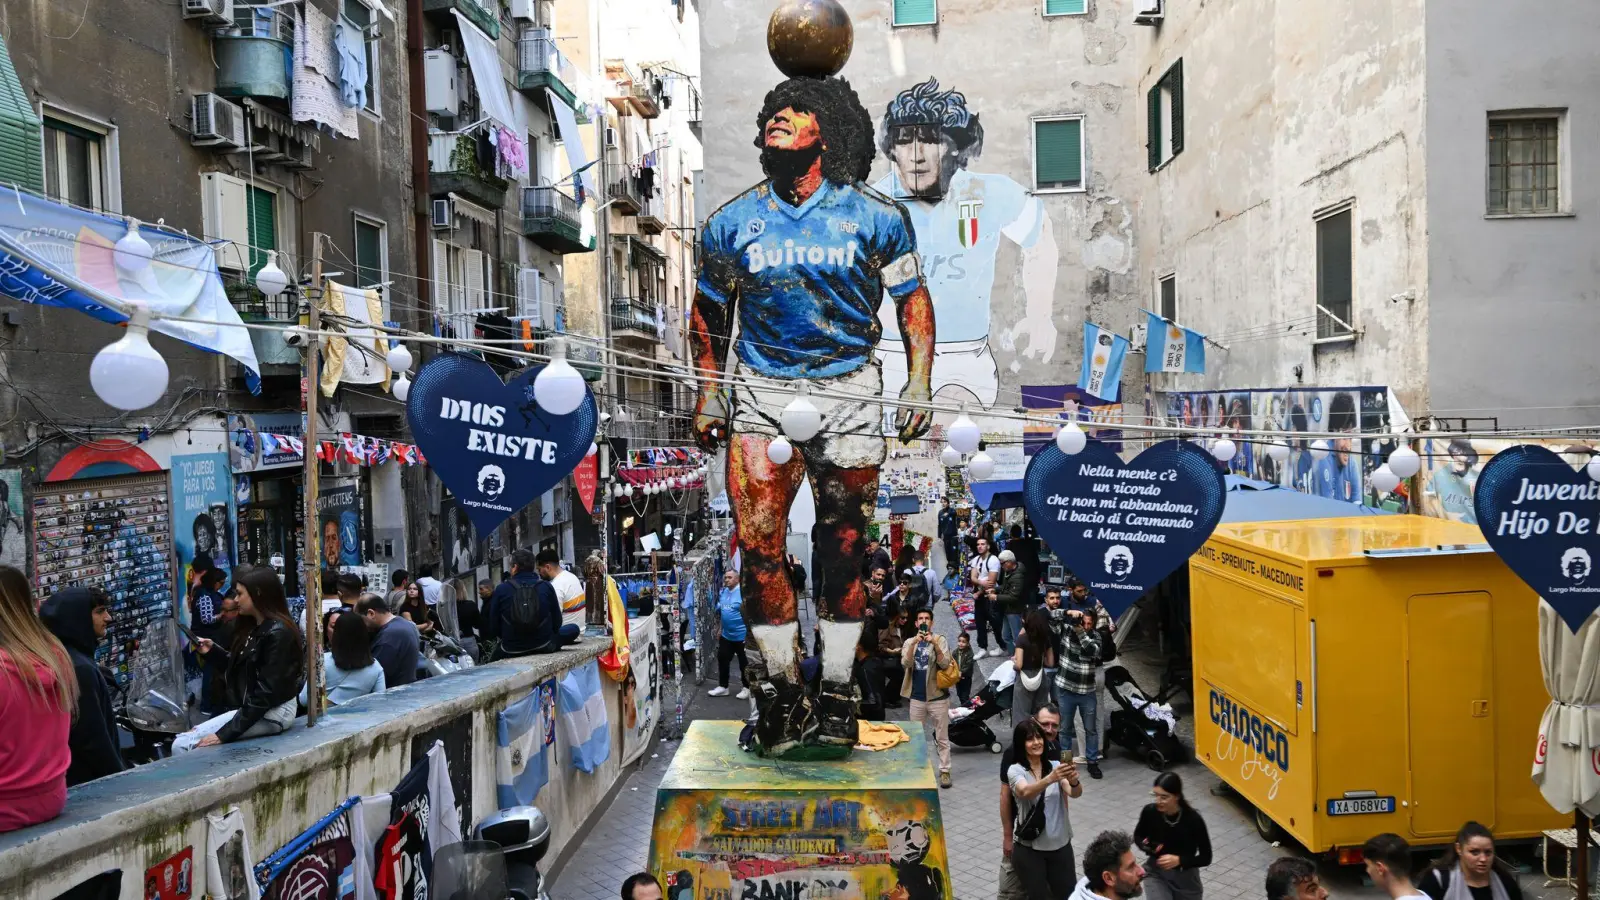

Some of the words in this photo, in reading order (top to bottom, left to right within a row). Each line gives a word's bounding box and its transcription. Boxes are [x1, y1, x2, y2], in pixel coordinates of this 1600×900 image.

[467, 429, 557, 464] EXISTE
[193, 460, 214, 475] JUEGO
[1079, 464, 1114, 478] Nella
[1117, 468, 1157, 480] mente
[1159, 468, 1177, 482] c'è
[184, 478, 200, 493] PARA
[1093, 483, 1110, 493] un
[1113, 483, 1161, 496] ricordo
[327, 491, 353, 508] MERTENS
[463, 498, 481, 508] Largo
[482, 502, 512, 512] Maradona
[1047, 495, 1069, 506] che
[1072, 497, 1097, 508] non
[1099, 497, 1117, 509] mi
[1058, 509, 1067, 521] Il
[1070, 511, 1104, 524] bacio
[1107, 513, 1120, 525] di
[1125, 513, 1194, 529] Carmando
[1497, 510, 1550, 540] Hijo
[1556, 511, 1591, 535] De
[1083, 530, 1092, 539] a
[1097, 528, 1166, 544] Maradona
[1221, 552, 1255, 575] SPREMUTE
[1260, 564, 1304, 592] MACEDONIE
[1091, 582, 1110, 591] Largo
[1111, 583, 1143, 592] Maradona
[1549, 586, 1569, 594] Largo
[1241, 729, 1282, 801] Diez
[722, 801, 806, 829] STREET
[813, 799, 863, 829] ART
[1337, 801, 1349, 813] XA
[1353, 799, 1387, 812] 068VC
[713, 837, 772, 853] SALVADOR
[775, 837, 836, 854] GAUDENTI
